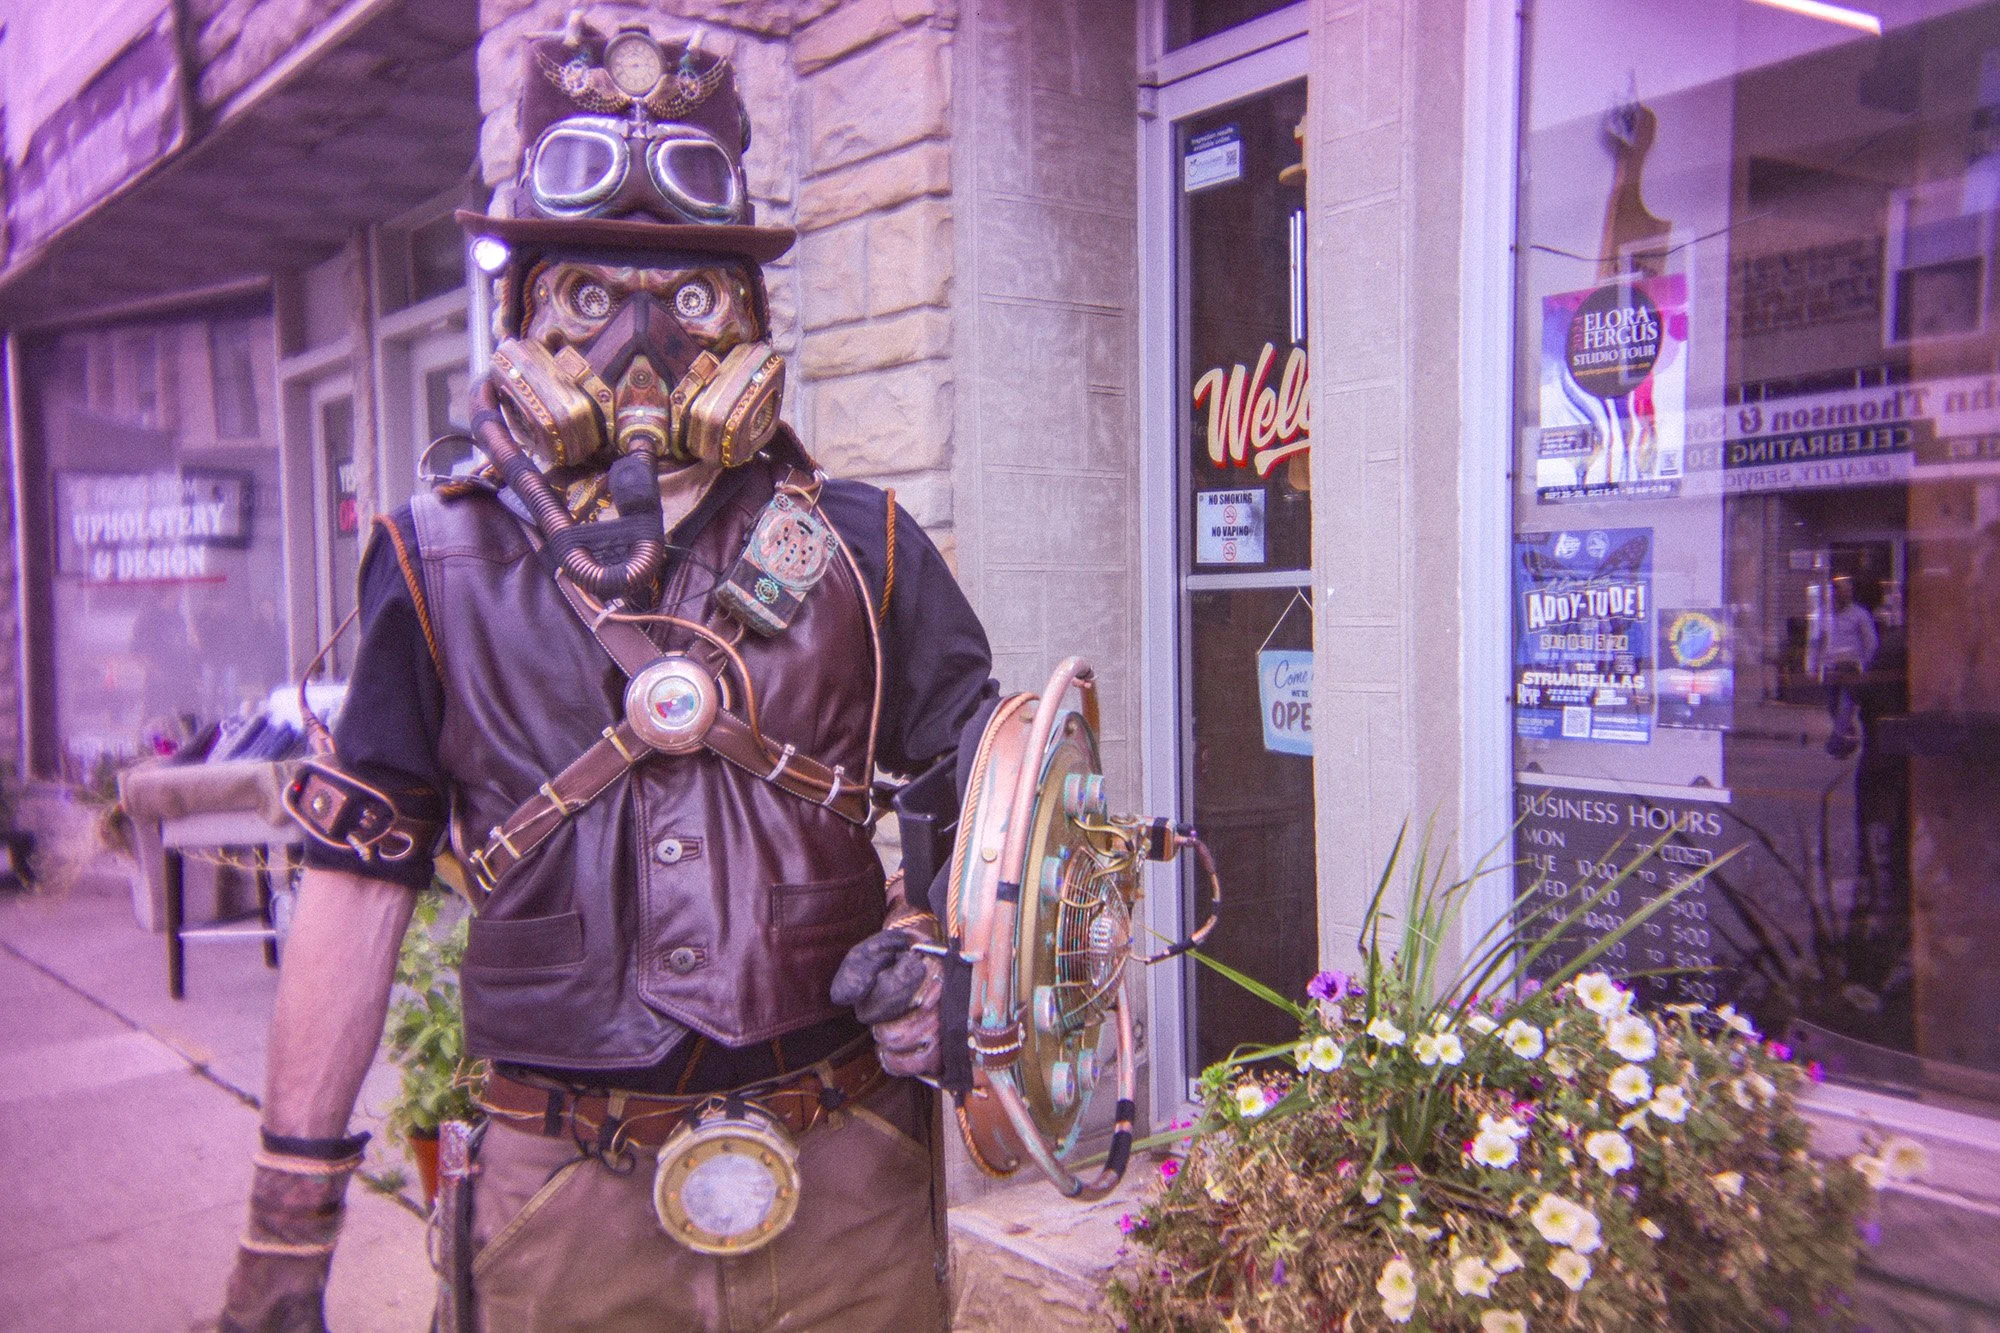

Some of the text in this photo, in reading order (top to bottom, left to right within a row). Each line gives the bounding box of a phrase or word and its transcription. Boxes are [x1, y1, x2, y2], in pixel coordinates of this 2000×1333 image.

[1584, 305, 1650, 334] ELORA
[1584, 321, 1658, 350] FERGUS
[1573, 344, 1656, 367] STUDIO TOUR
[1209, 493, 1253, 505] NO SMOKING
[72, 503, 224, 544] UPHOLSTERY
[1212, 525, 1249, 537] NO VAPING
[117, 545, 206, 581] DESIGN
[1528, 585, 1645, 629] ADDY-TUDE!
[1541, 633, 1565, 650] SAT
[1567, 633, 1593, 650] OCT
[1275, 660, 1308, 689] Come
[1522, 672, 1645, 689] STRUMBELLAS
[1272, 701, 1312, 731] OPE
[1518, 794, 1722, 836] BUSINESS HOURS
[1523, 828, 1566, 848] MON
[1526, 852, 1557, 872] TUE
[1538, 879, 1568, 898] ED
